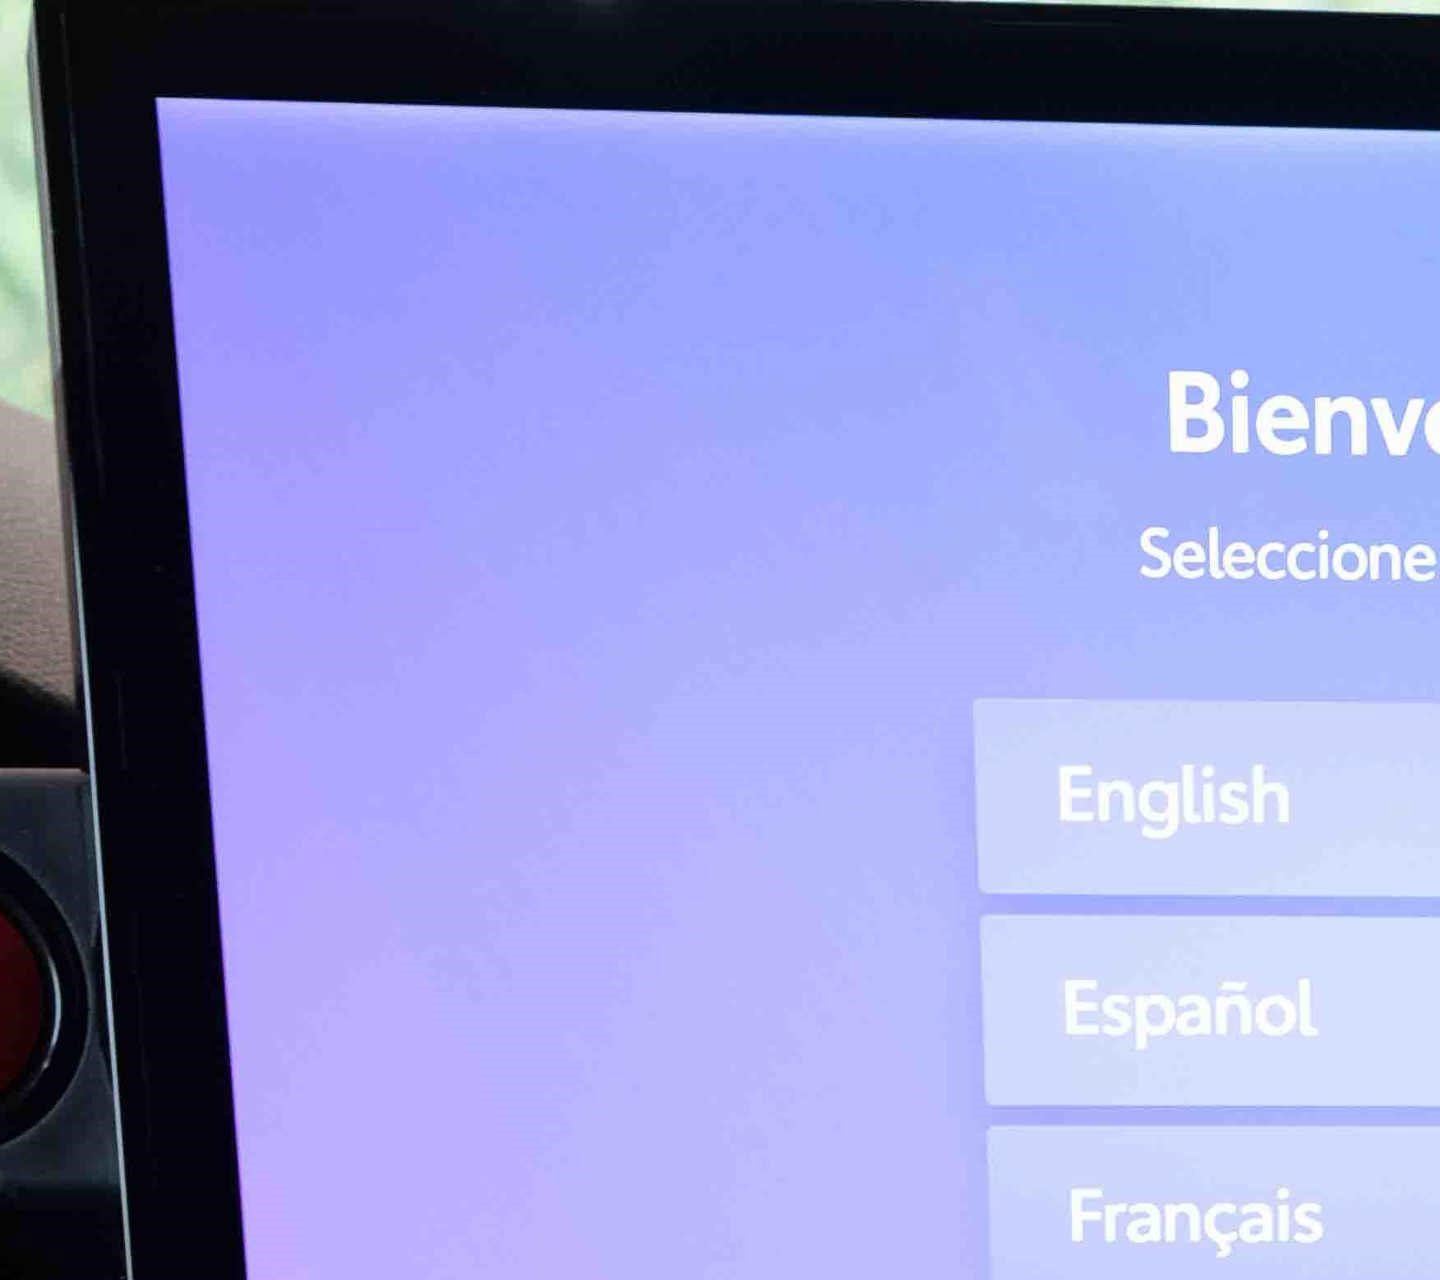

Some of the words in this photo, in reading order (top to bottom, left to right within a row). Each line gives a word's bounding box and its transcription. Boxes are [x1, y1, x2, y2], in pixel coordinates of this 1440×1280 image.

[1138, 526, 1438, 583] Seleccione
[1057, 763, 1292, 840] English
[1063, 978, 1320, 1051] Español
[1070, 1186, 1325, 1259] Français
